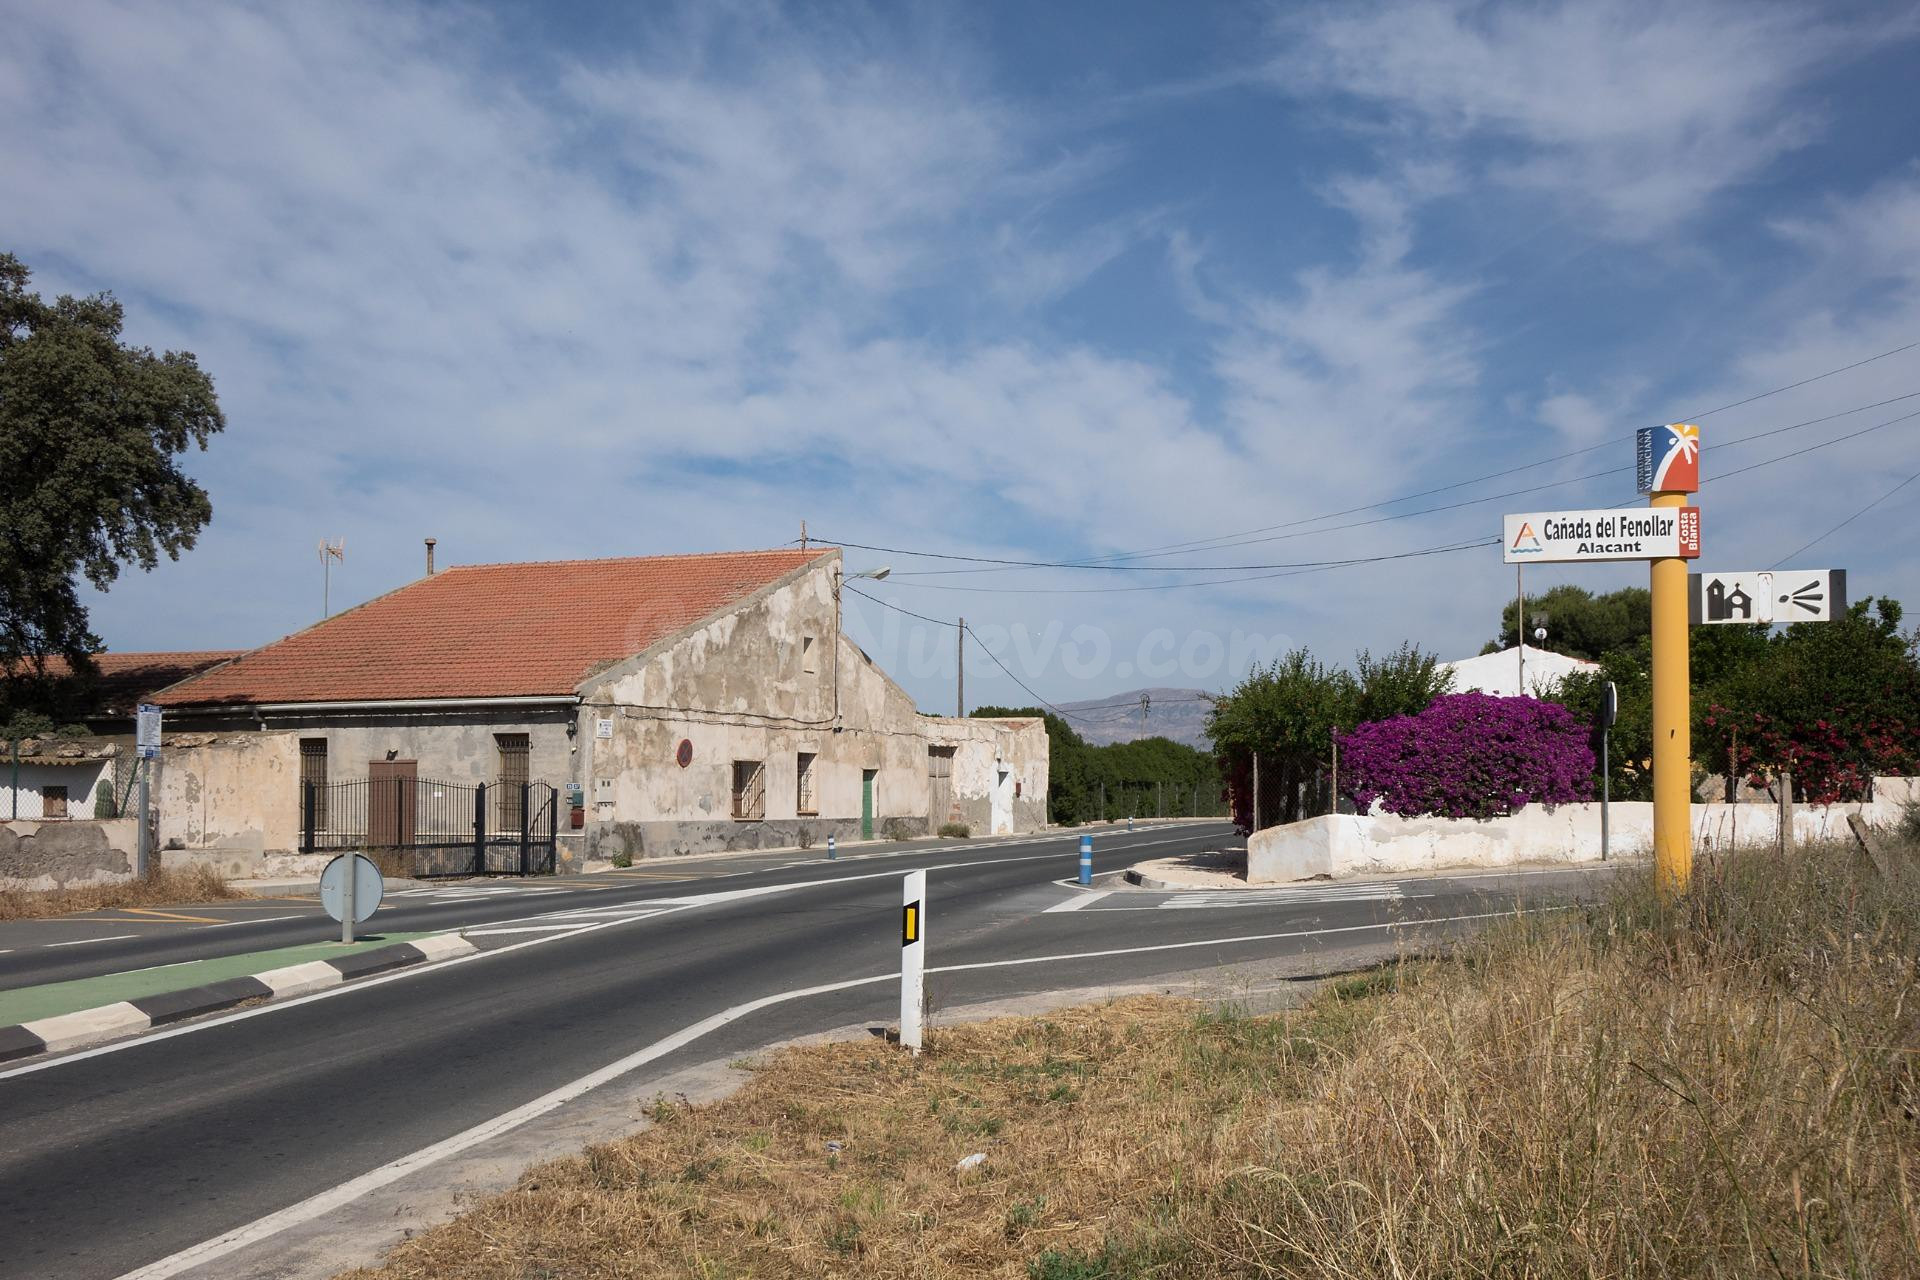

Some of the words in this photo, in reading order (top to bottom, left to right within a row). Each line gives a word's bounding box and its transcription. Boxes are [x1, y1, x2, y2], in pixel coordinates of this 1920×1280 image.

[1644, 429, 1652, 489] VALENCIANA
[1544, 517, 1592, 540] Cañada
[1596, 516, 1615, 538] del
[1620, 515, 1674, 538] Fenollar
[1680, 512, 1689, 544] Costa
[1689, 512, 1698, 551] Blanca
[1577, 541, 1642, 554] Alacant
